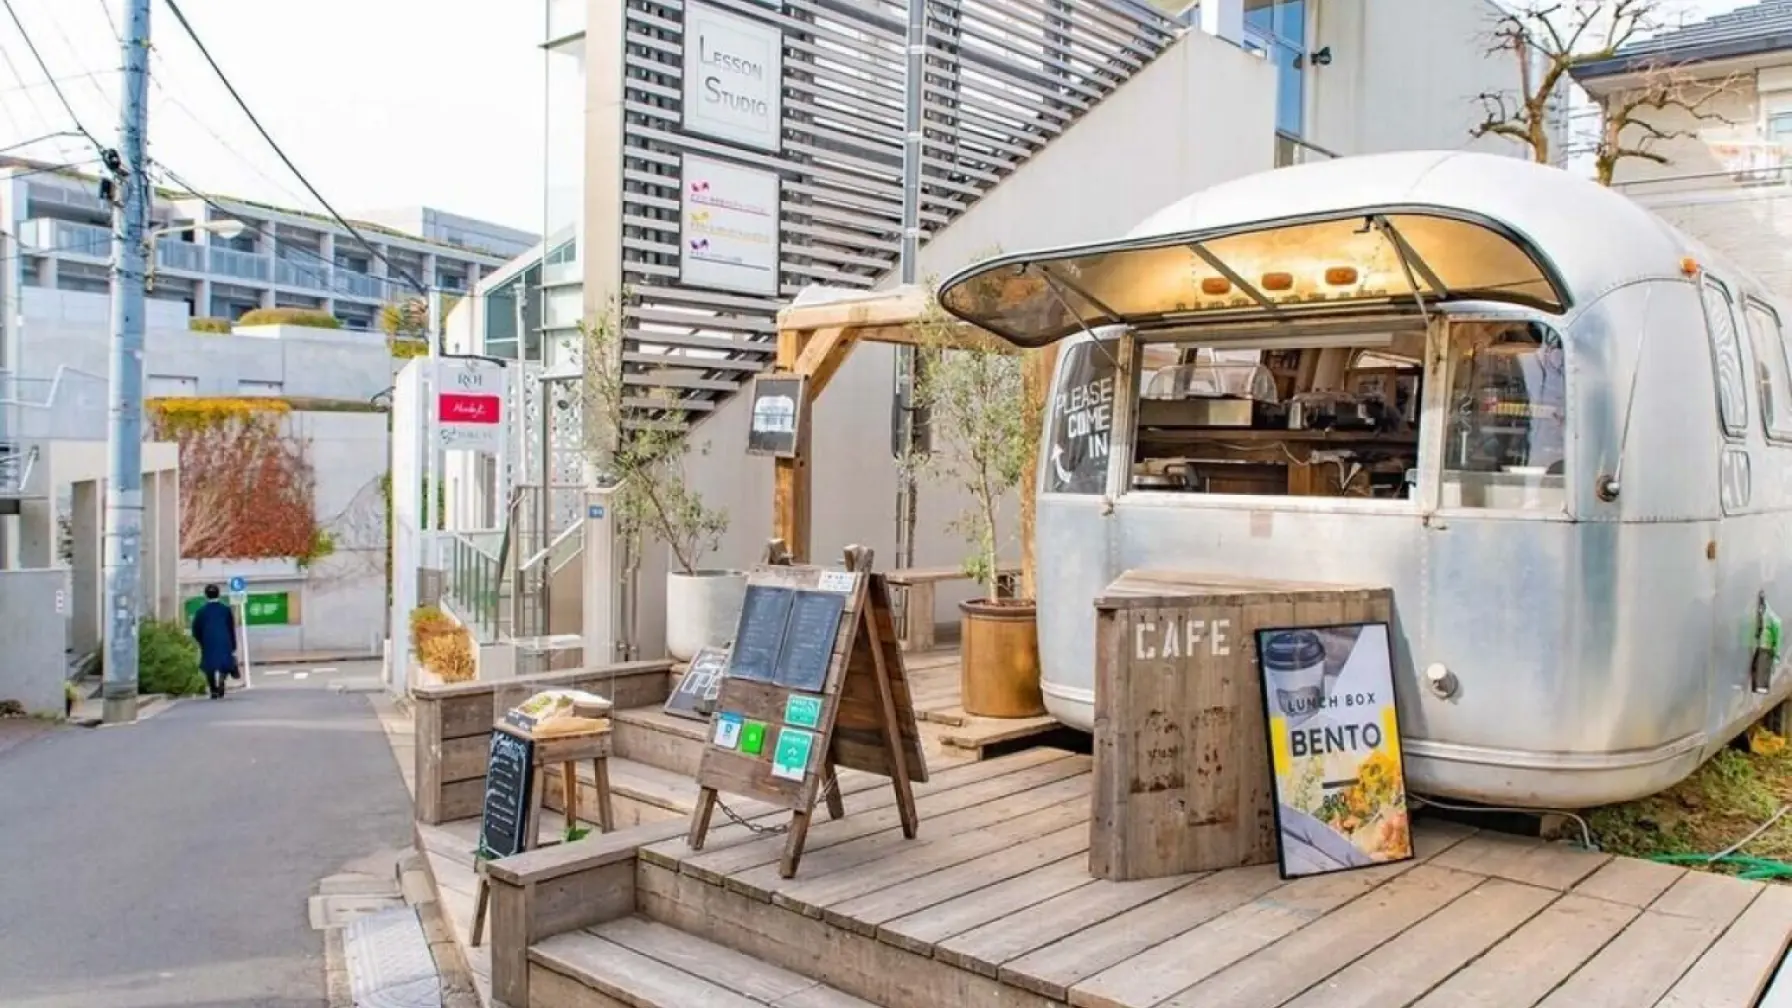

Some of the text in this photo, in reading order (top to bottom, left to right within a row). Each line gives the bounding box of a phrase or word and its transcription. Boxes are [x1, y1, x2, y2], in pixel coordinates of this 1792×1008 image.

[1056, 376, 1113, 415] PLEASE
[1068, 404, 1110, 438] COME
[1088, 432, 1108, 459] IN
[1135, 619, 1230, 660] CAFE
[1287, 692, 1376, 713] LUNCH BOX
[1291, 722, 1382, 758] BENTO
